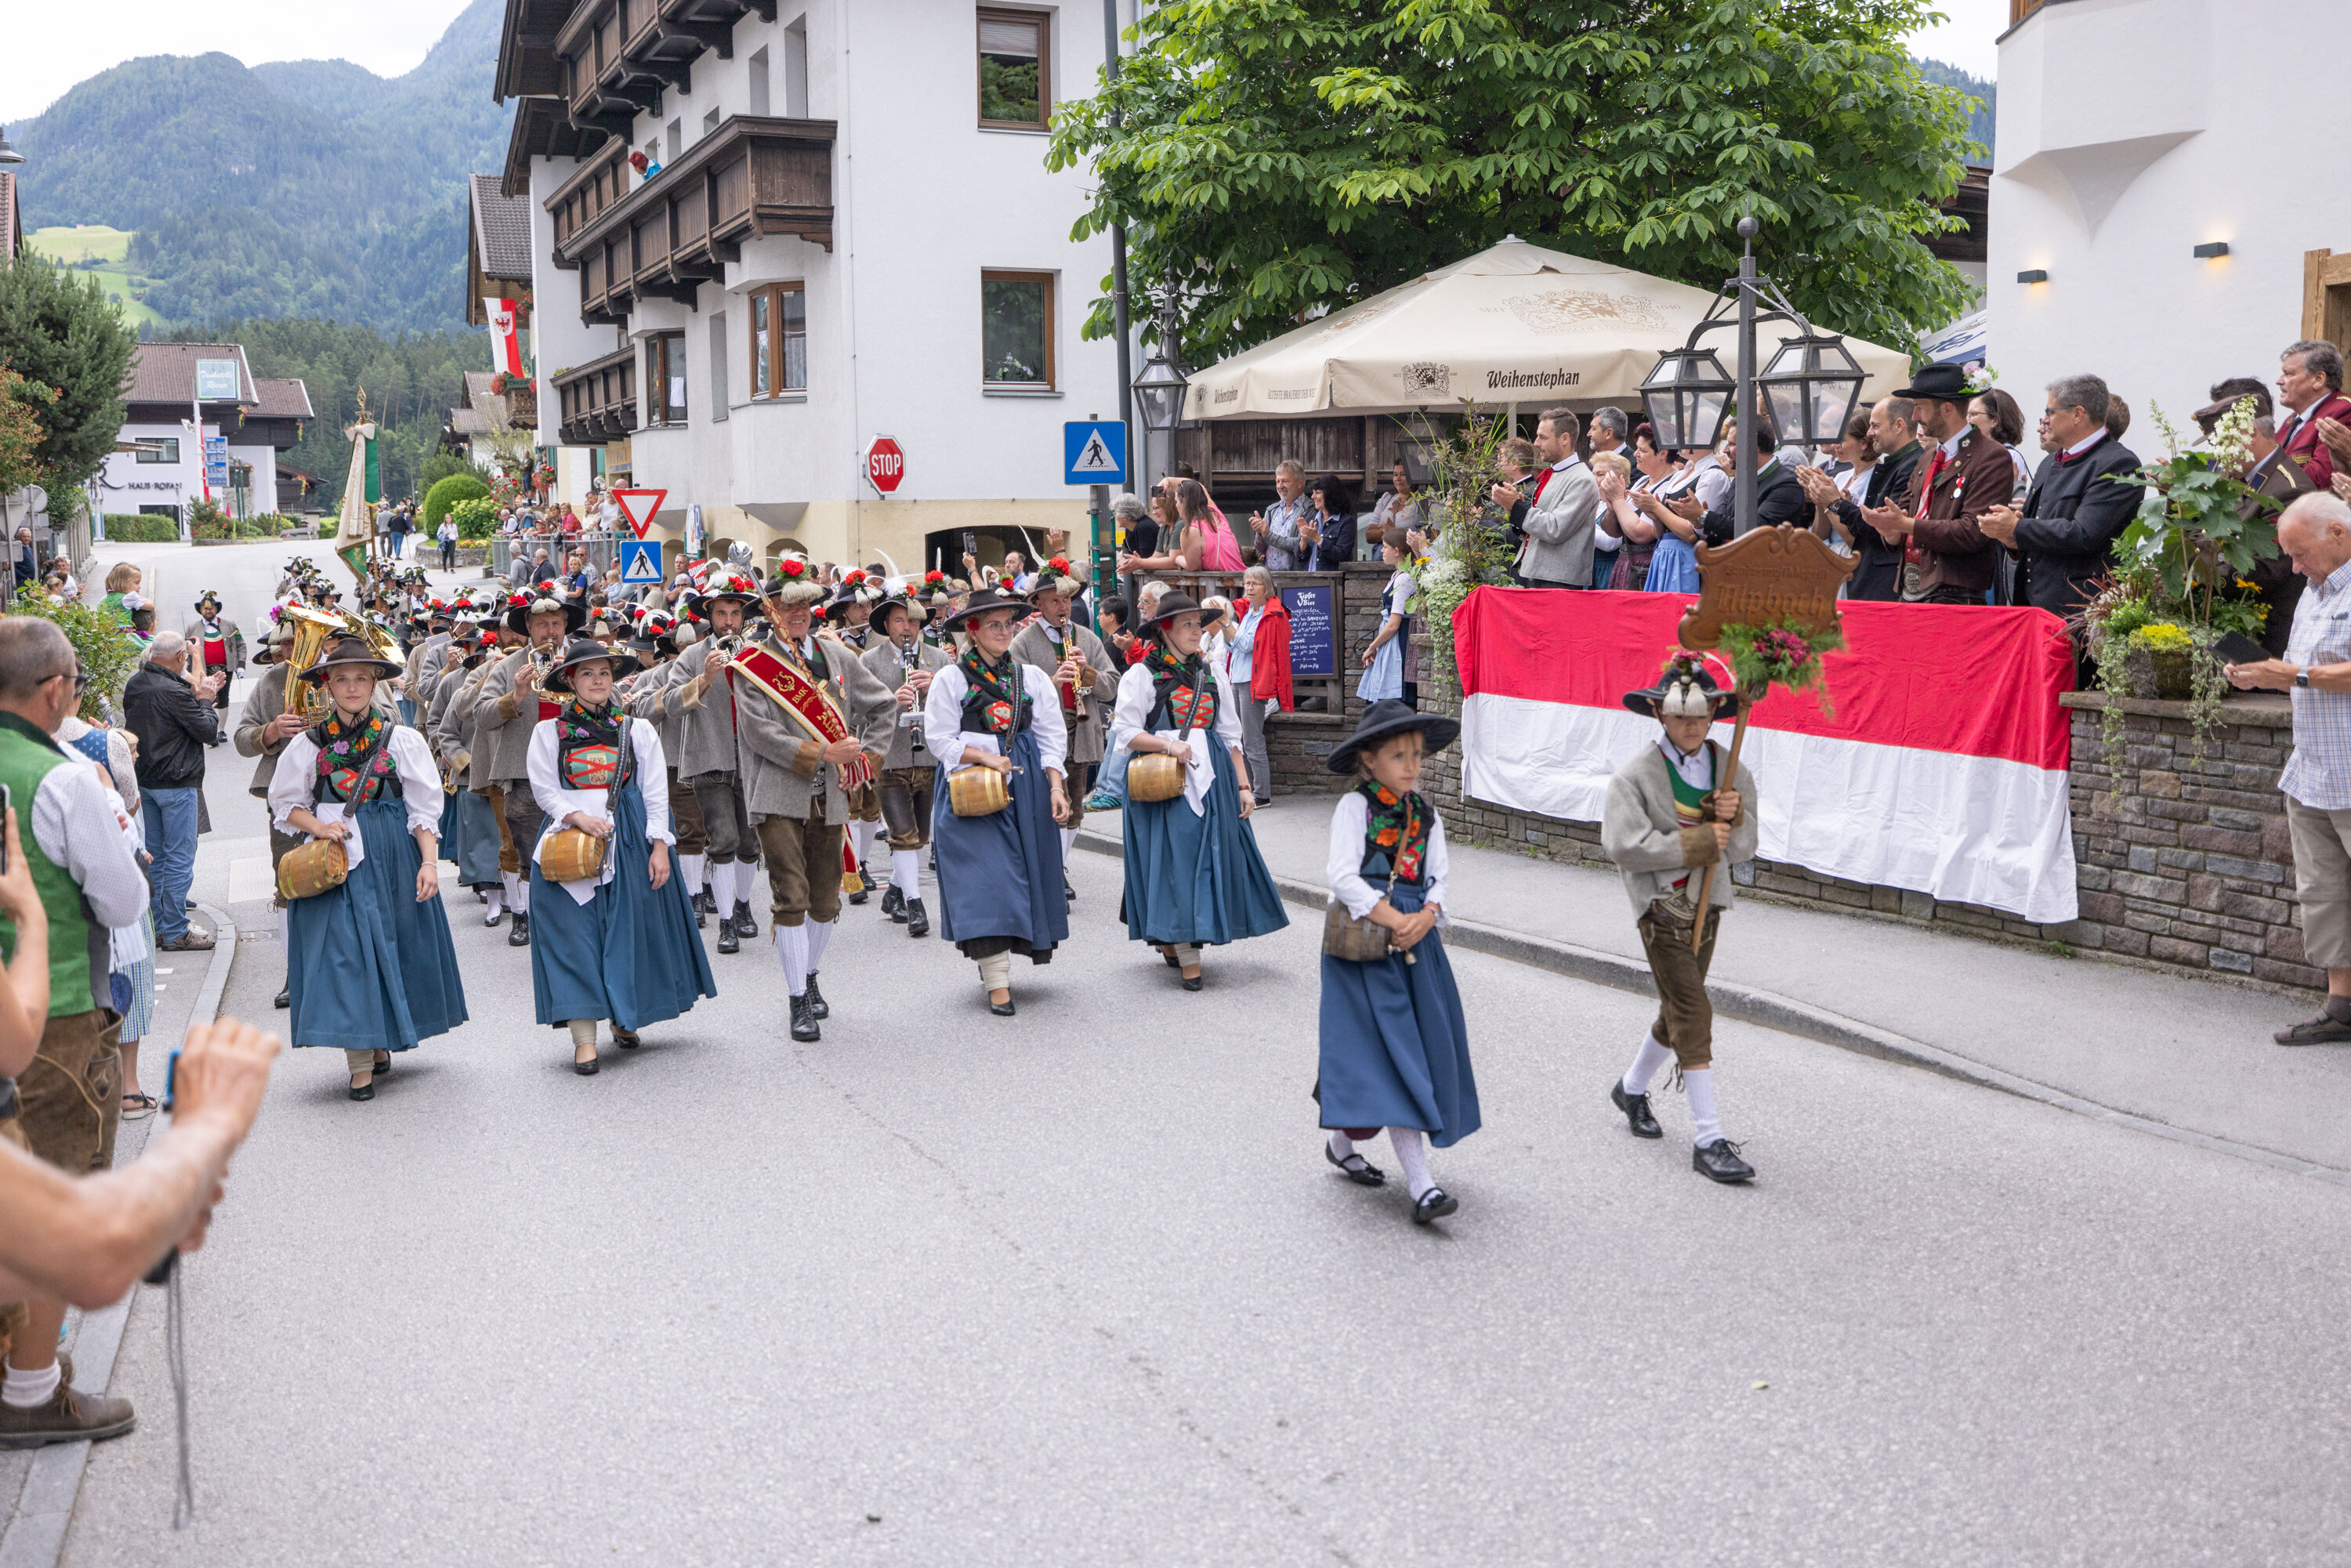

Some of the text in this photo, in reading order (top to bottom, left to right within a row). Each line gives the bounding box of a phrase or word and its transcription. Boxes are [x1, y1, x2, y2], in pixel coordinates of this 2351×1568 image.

[1487, 368, 1580, 389] Weihenstephan
[1215, 385, 1238, 405] Weihenstephan
[871, 454, 901, 476] STOP
[1297, 592, 1316, 602] Zipfer
[1717, 583, 1826, 624] Alpbach
[792, 686, 809, 704] BMK
